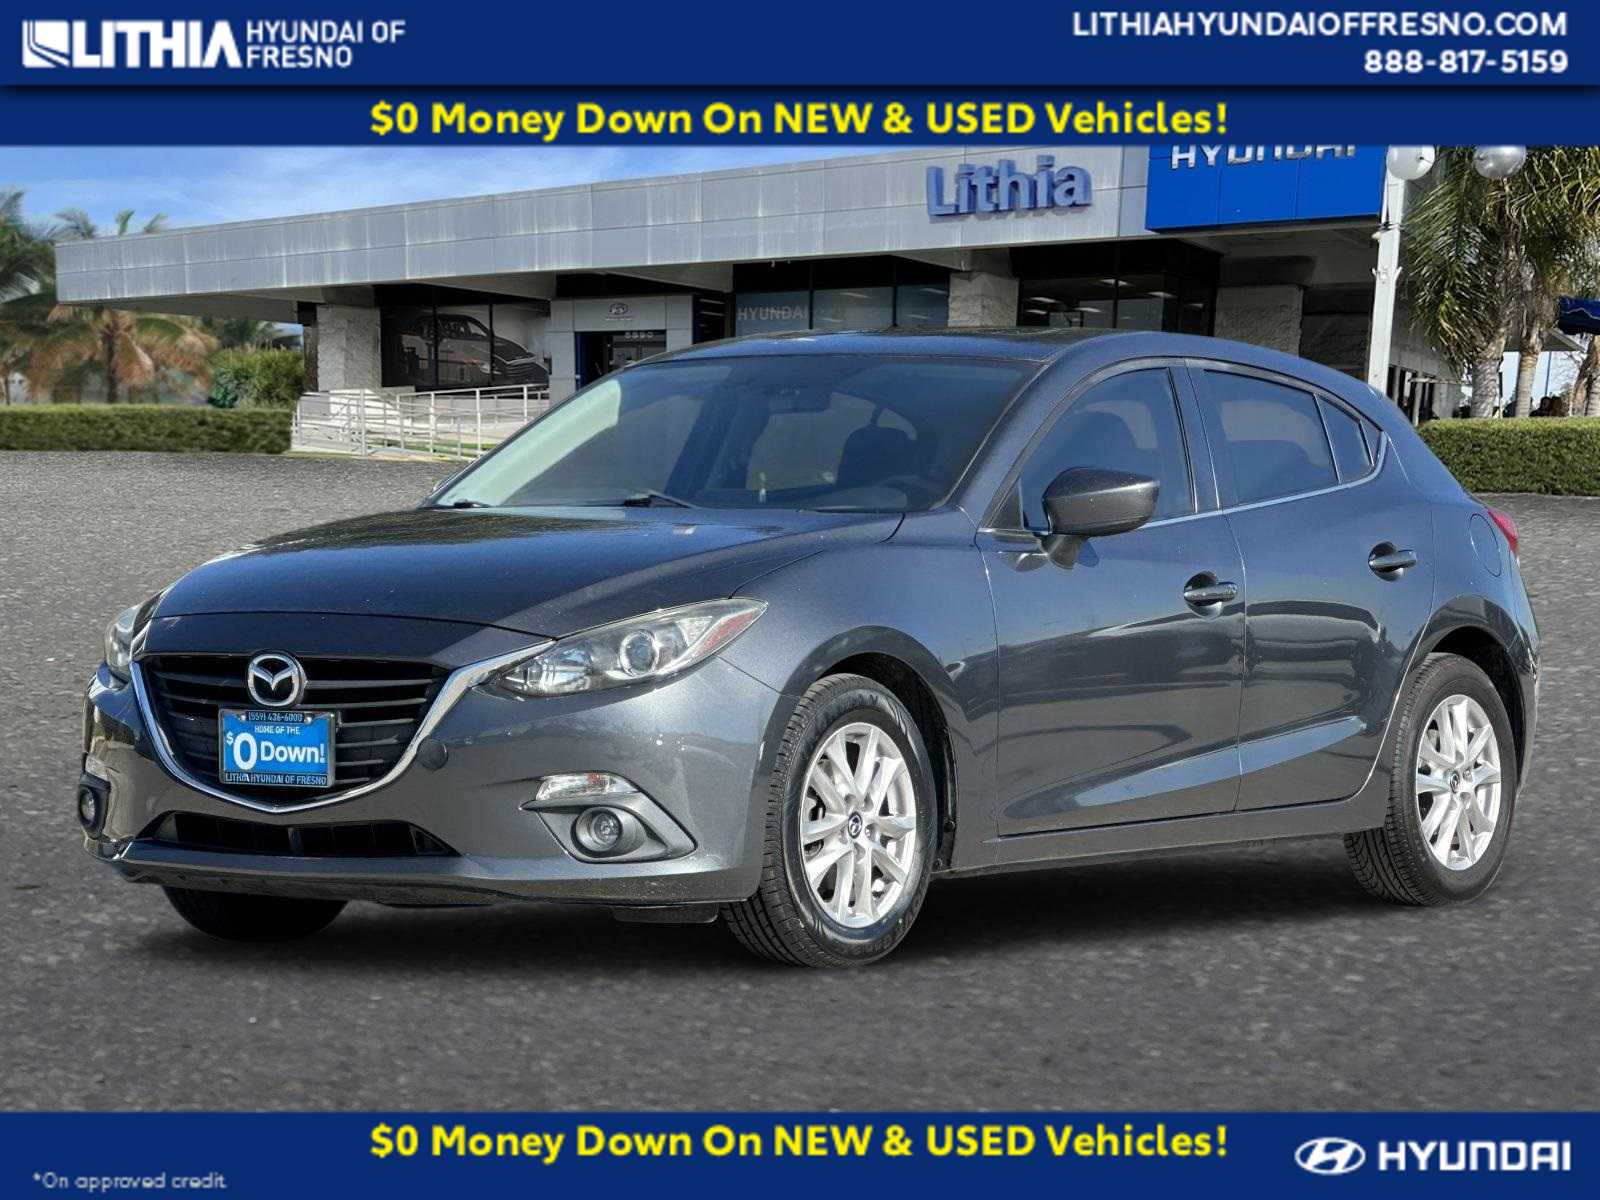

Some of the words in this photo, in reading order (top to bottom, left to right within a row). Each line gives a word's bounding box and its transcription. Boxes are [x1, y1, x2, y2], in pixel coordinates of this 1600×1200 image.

[926, 155, 1093, 215] Lithia
[737, 305, 809, 321] HYUNDAI
[254, 725, 275, 735] HOME
[275, 726, 286, 735] OF
[286, 726, 301, 736] THE
[260, 741, 326, 764] Down!
[250, 773, 284, 784] HYUNDAI
[284, 774, 295, 784] OF
[296, 775, 327, 786] FRESNO
